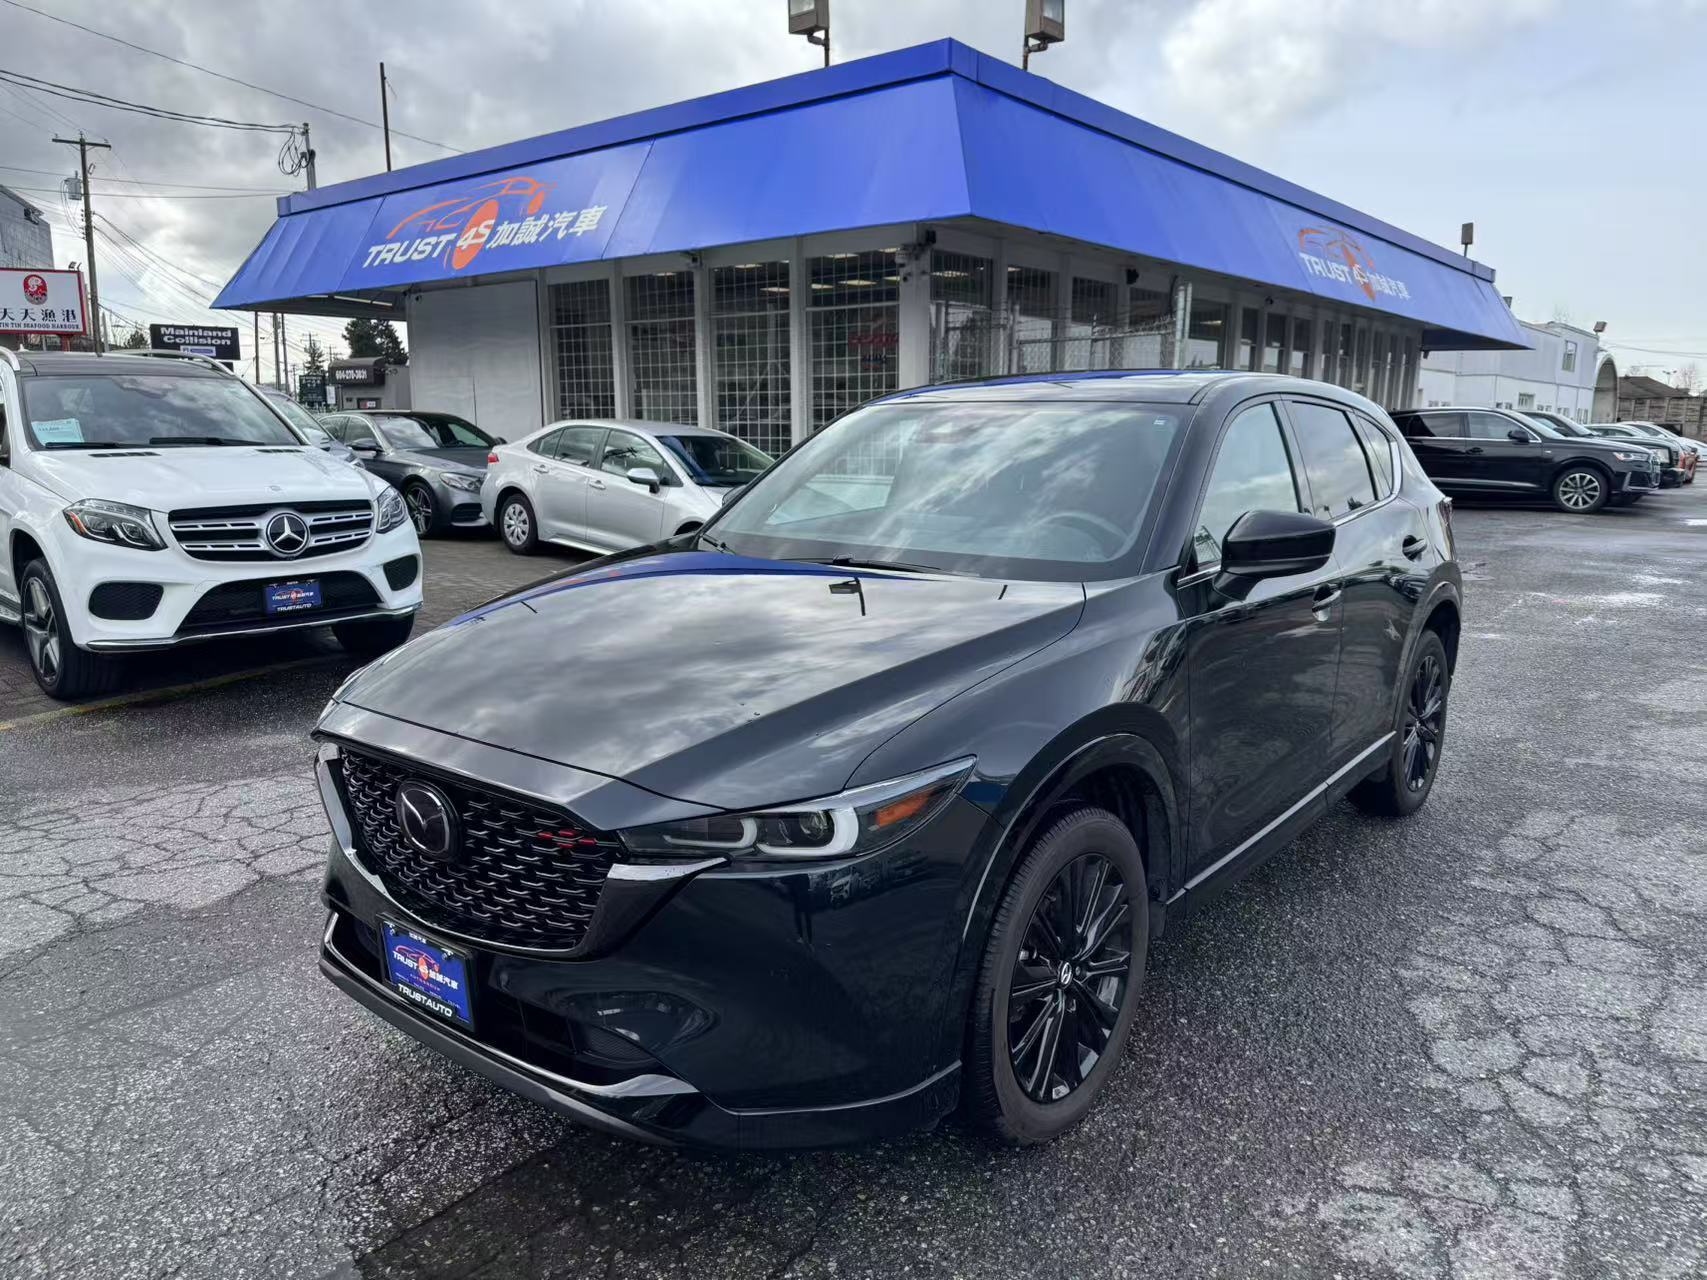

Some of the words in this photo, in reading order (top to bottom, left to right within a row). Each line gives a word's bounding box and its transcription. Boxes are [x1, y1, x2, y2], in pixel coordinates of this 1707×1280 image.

[363, 233, 456, 268] TRUST
[455, 219, 495, 250] 4S
[1299, 252, 1352, 284] TRUST
[160, 327, 232, 337] Mainland
[163, 335, 231, 345] Collision
[393, 951, 418, 969] TRUST
[398, 983, 453, 1016] TRUSTAUTO
